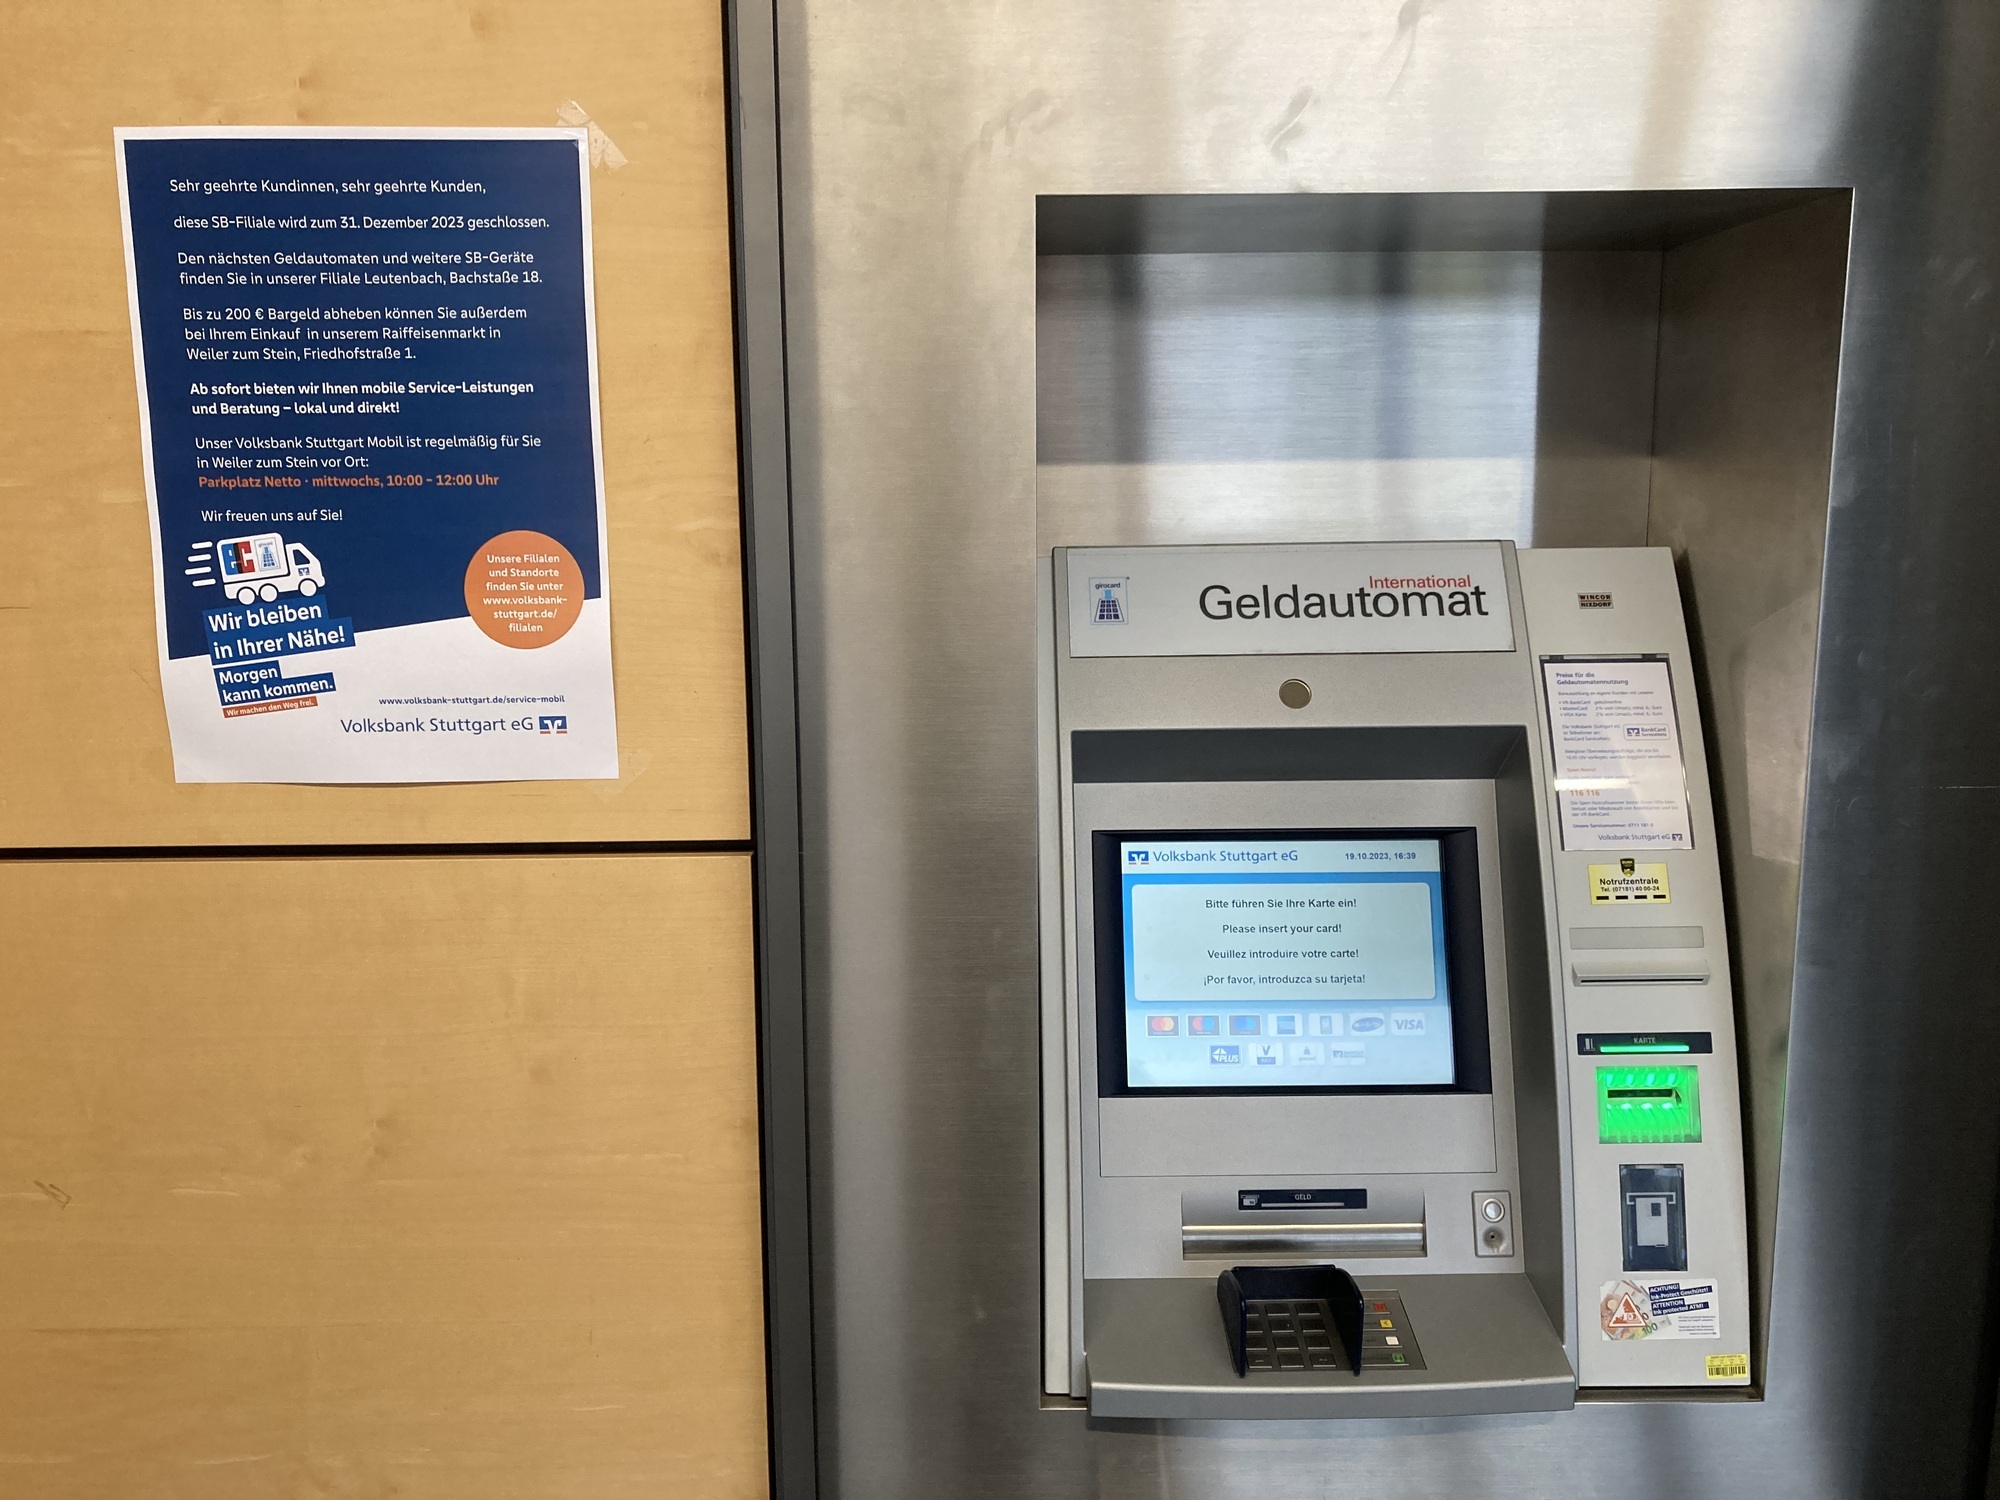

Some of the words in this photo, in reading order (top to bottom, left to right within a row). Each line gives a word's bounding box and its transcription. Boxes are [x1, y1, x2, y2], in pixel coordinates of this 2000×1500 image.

[169, 178, 201, 192] Sehr
[203, 178, 258, 195] geehrte
[261, 179, 339, 195] Kundinnen,
[341, 179, 371, 193] sehr
[373, 179, 427, 196] geehrte
[430, 179, 486, 194] Kunden,
[173, 215, 209, 229] diese
[211, 215, 276, 229] SB-Filiale
[277, 215, 308, 229] wird
[310, 219, 337, 229] zum
[340, 216, 361, 229] 31.
[362, 215, 429, 229] Dezember
[431, 215, 465, 229] 2023
[467, 215, 550, 232] geschlossen.
[177, 252, 205, 265] Den
[208, 251, 271, 265] nächsten
[273, 251, 379, 265] Geldautomaten
[382, 251, 409, 265] und
[411, 251, 462, 264] weitere
[464, 251, 534, 264] SB-Geräte
[179, 271, 224, 285] finden
[226, 272, 248, 285] Sie
[250, 272, 263, 285] in
[266, 274, 317, 285] unserer
[319, 271, 361, 285] Filiale
[364, 271, 447, 286] Leutenbach,
[449, 270, 519, 284] Bachstaße
[522, 270, 543, 283] 18.
[183, 307, 203, 321] Bis
[206, 310, 222, 321] zu
[225, 307, 251, 321] 200
[254, 307, 264, 320] €
[267, 307, 320, 323] Bargeld
[323, 307, 382, 320] abheben
[384, 307, 434, 320] können
[437, 306, 457, 319] Sie
[460, 305, 527, 319] außerdem
[184, 327, 206, 341] bei
[209, 327, 247, 340] Ihrem
[250, 327, 301, 340] Einkauf
[306, 327, 320, 340] in
[322, 330, 379, 340] unserem
[382, 326, 486, 340] Raiffeisenmarkt
[488, 326, 501, 339] in
[186, 347, 229, 360] Weiler
[232, 350, 260, 360] zum
[262, 347, 301, 362] Stein,
[303, 346, 401, 360] Friedhofstraße
[404, 346, 416, 359] 1.
[190, 382, 209, 395] Ab
[211, 382, 252, 395] sofort
[253, 382, 296, 395] bieten
[297, 381, 320, 395] wir
[321, 381, 359, 395] Ihnen
[361, 381, 406, 394] mobile
[408, 380, 534, 396] Service-Leistungen
[191, 402, 218, 415] und
[220, 402, 280, 417] Beratung
[294, 401, 328, 414] lokal
[329, 401, 355, 414] und
[357, 401, 400, 414] direkt!
[195, 437, 233, 450] Unser
[234, 436, 303, 449] Volksbank
[305, 436, 365, 451] Stuttgart
[367, 435, 405, 448] Mobil
[406, 435, 422, 448] ist
[424, 434, 498, 451] regelmäßig
[500, 434, 520, 447] für
[521, 434, 542, 447] Sie
[198, 475, 262, 491] Parkplatz
[264, 475, 302, 488] Netto
[311, 474, 384, 488] mittwochs,
[386, 474, 424, 487] 10:00
[435, 473, 473, 486] 12:00
[475, 473, 500, 486] Uhr
[486, 554, 522, 564] Unsere
[523, 553, 560, 564] Filialen
[488, 567, 508, 577] und
[510, 567, 560, 577] Standorte
[485, 582, 517, 591] finden
[519, 582, 534, 591] Sie
[537, 582, 563, 591] unter
[1095, 582, 1121, 590] girocard
[1368, 575, 1471, 590] International
[482, 595, 568, 605] www.volksbank-
[1199, 584, 1489, 619] Geldautomat
[208, 612, 243, 632] Wir
[246, 604, 322, 627] bleiben
[493, 609, 558, 620] stuttgart.de/
[508, 623, 543, 632] filialen
[213, 642, 233, 660] in
[236, 637, 284, 656] Ihrer
[287, 625, 346, 649] Nähe!
[218, 667, 278, 685] Morgen
[222, 689, 261, 703] kann
[263, 678, 334, 698] kommen.
[378, 694, 566, 706] www.volksbank-stuttgart.de/service-mobil
[226, 709, 239, 717] Wir
[239, 705, 268, 715] machen
[268, 703, 282, 711] den
[282, 701, 298, 709] Weg
[299, 699, 314, 707] frei.
[340, 717, 426, 733] Volksbank
[429, 717, 507, 736] Stuttgart
[510, 716, 534, 731] eG
[1631, 834, 1660, 842] Stuttgart
[1152, 850, 1217, 862] Volksbank
[1219, 850, 1278, 865] Stuttgart
[1280, 849, 1299, 862] eG
[1345, 852, 1392, 861] 19.10.2023,
[1393, 851, 1417, 860] 16:39
[1599, 877, 1659, 885] Notrufzentrale
[1205, 899, 1229, 909] Bitte
[1231, 899, 1265, 908] führen
[1267, 899, 1284, 908] Sie
[1285, 898, 1306, 908] Ihre
[1308, 898, 1336, 908] Karte
[1337, 898, 1357, 908] ein!
[1222, 924, 1256, 934] Please
[1258, 924, 1288, 934] insert
[1289, 925, 1314, 936] your
[1316, 923, 1342, 933] card!
[1207, 949, 1247, 959] Veuillez
[1249, 949, 1299, 959] introduire
[1301, 949, 1328, 959] votre
[1330, 948, 1359, 958] carte!
[1203, 975, 1225, 987] ¡Por
[1227, 975, 1256, 985] favor,
[1258, 974, 1313, 984] introduzca
[1314, 976, 1328, 984] su
[1330, 973, 1366, 986] tarjeta!
[1393, 1019, 1424, 1030] VISA
[1219, 1054, 1239, 1063] PLUS
[1652, 1300, 1684, 1309] ATTENTION
